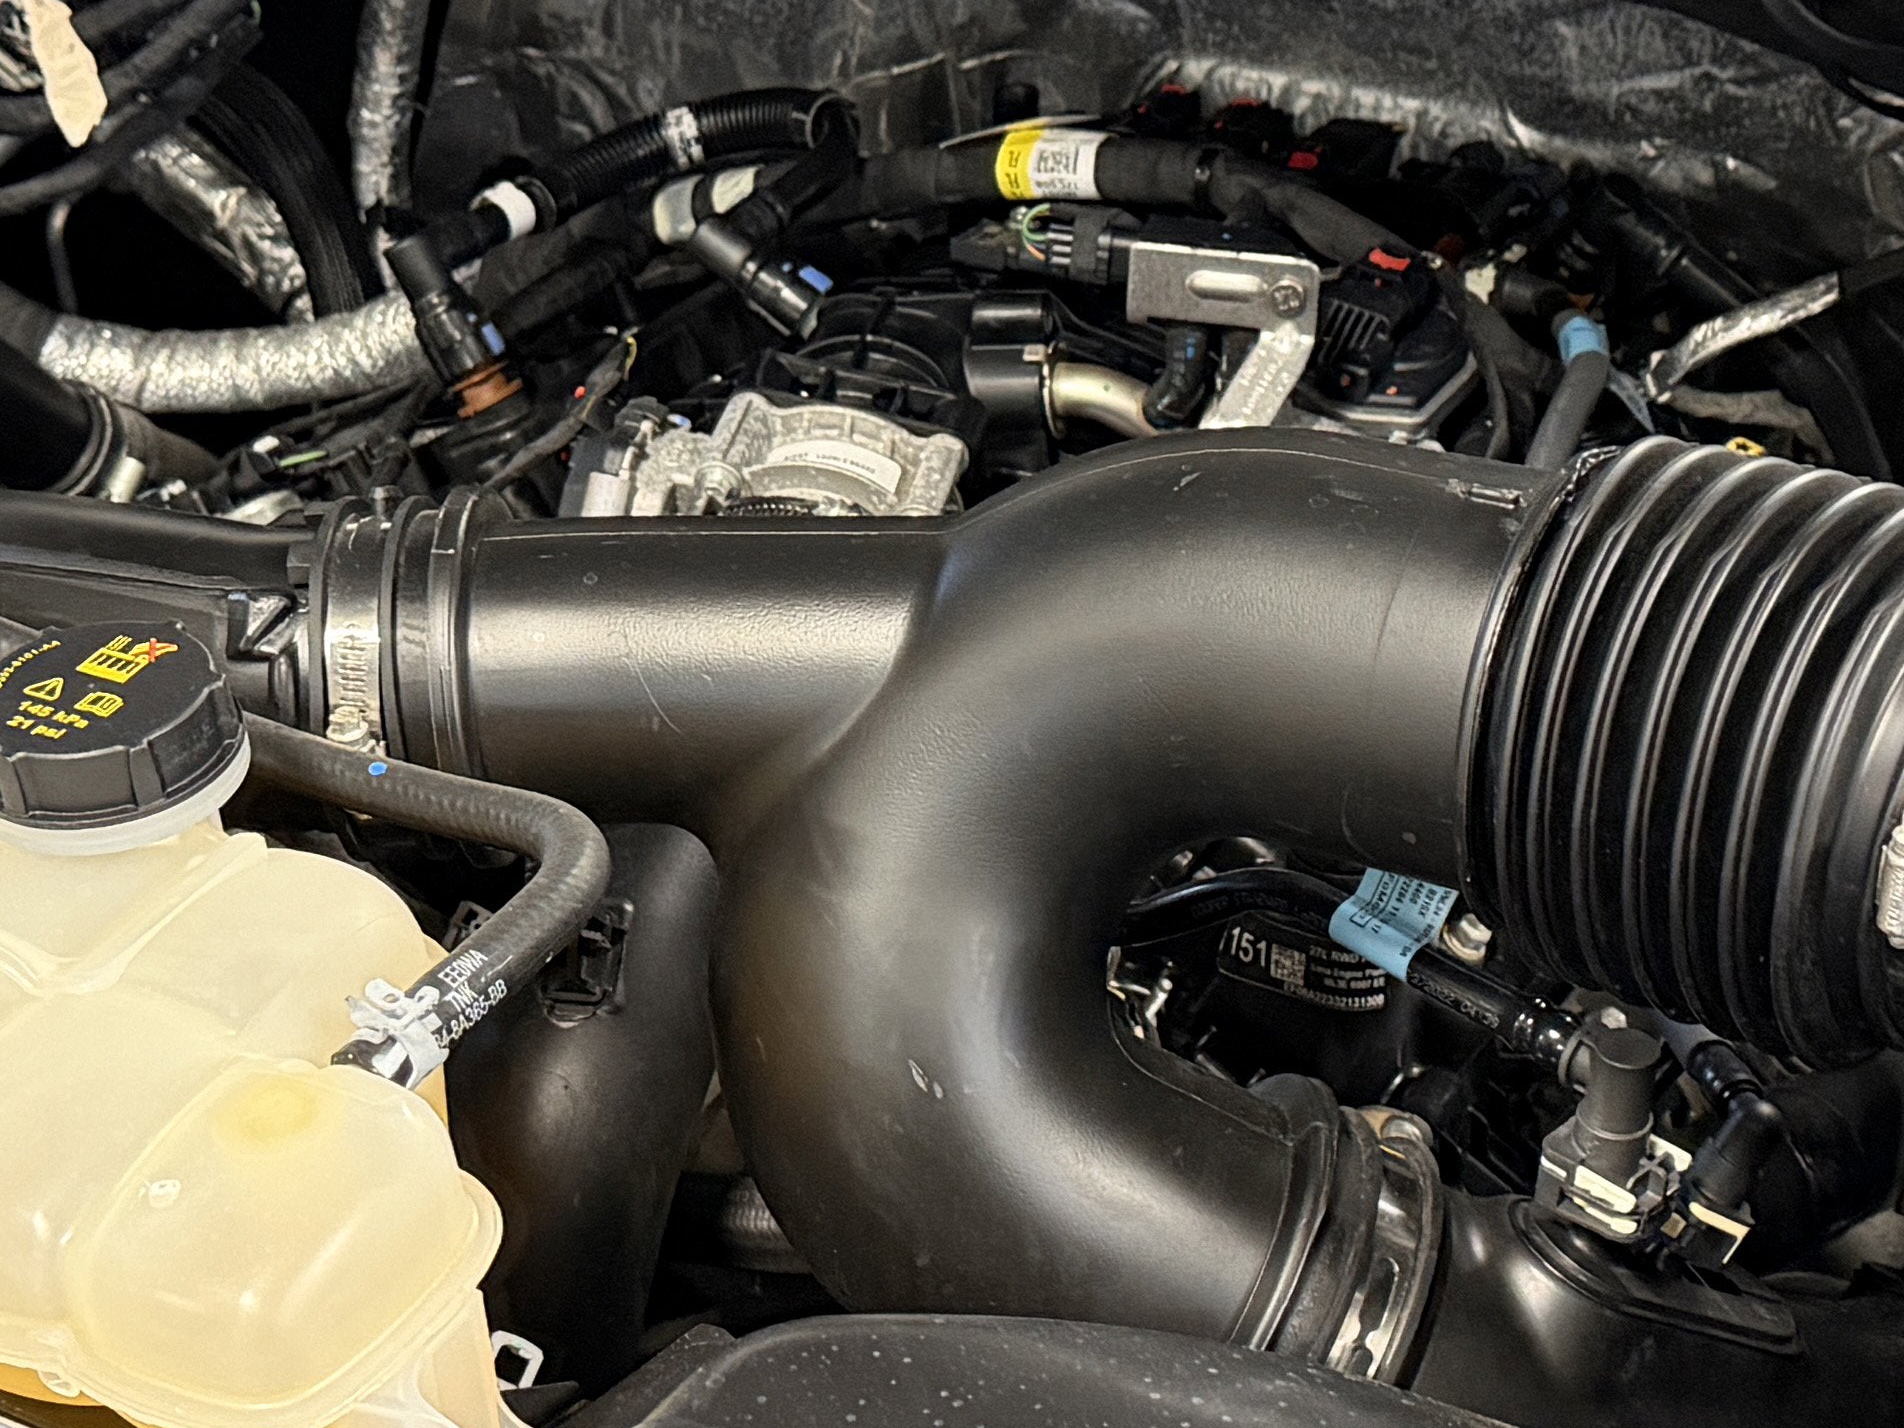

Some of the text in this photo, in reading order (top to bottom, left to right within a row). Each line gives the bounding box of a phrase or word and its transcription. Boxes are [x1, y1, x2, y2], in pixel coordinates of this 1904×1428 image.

[6, 716, 68, 740] 21 psi
[18, 701, 90, 729] 145 kPa
[441, 980, 478, 1013] TNK
